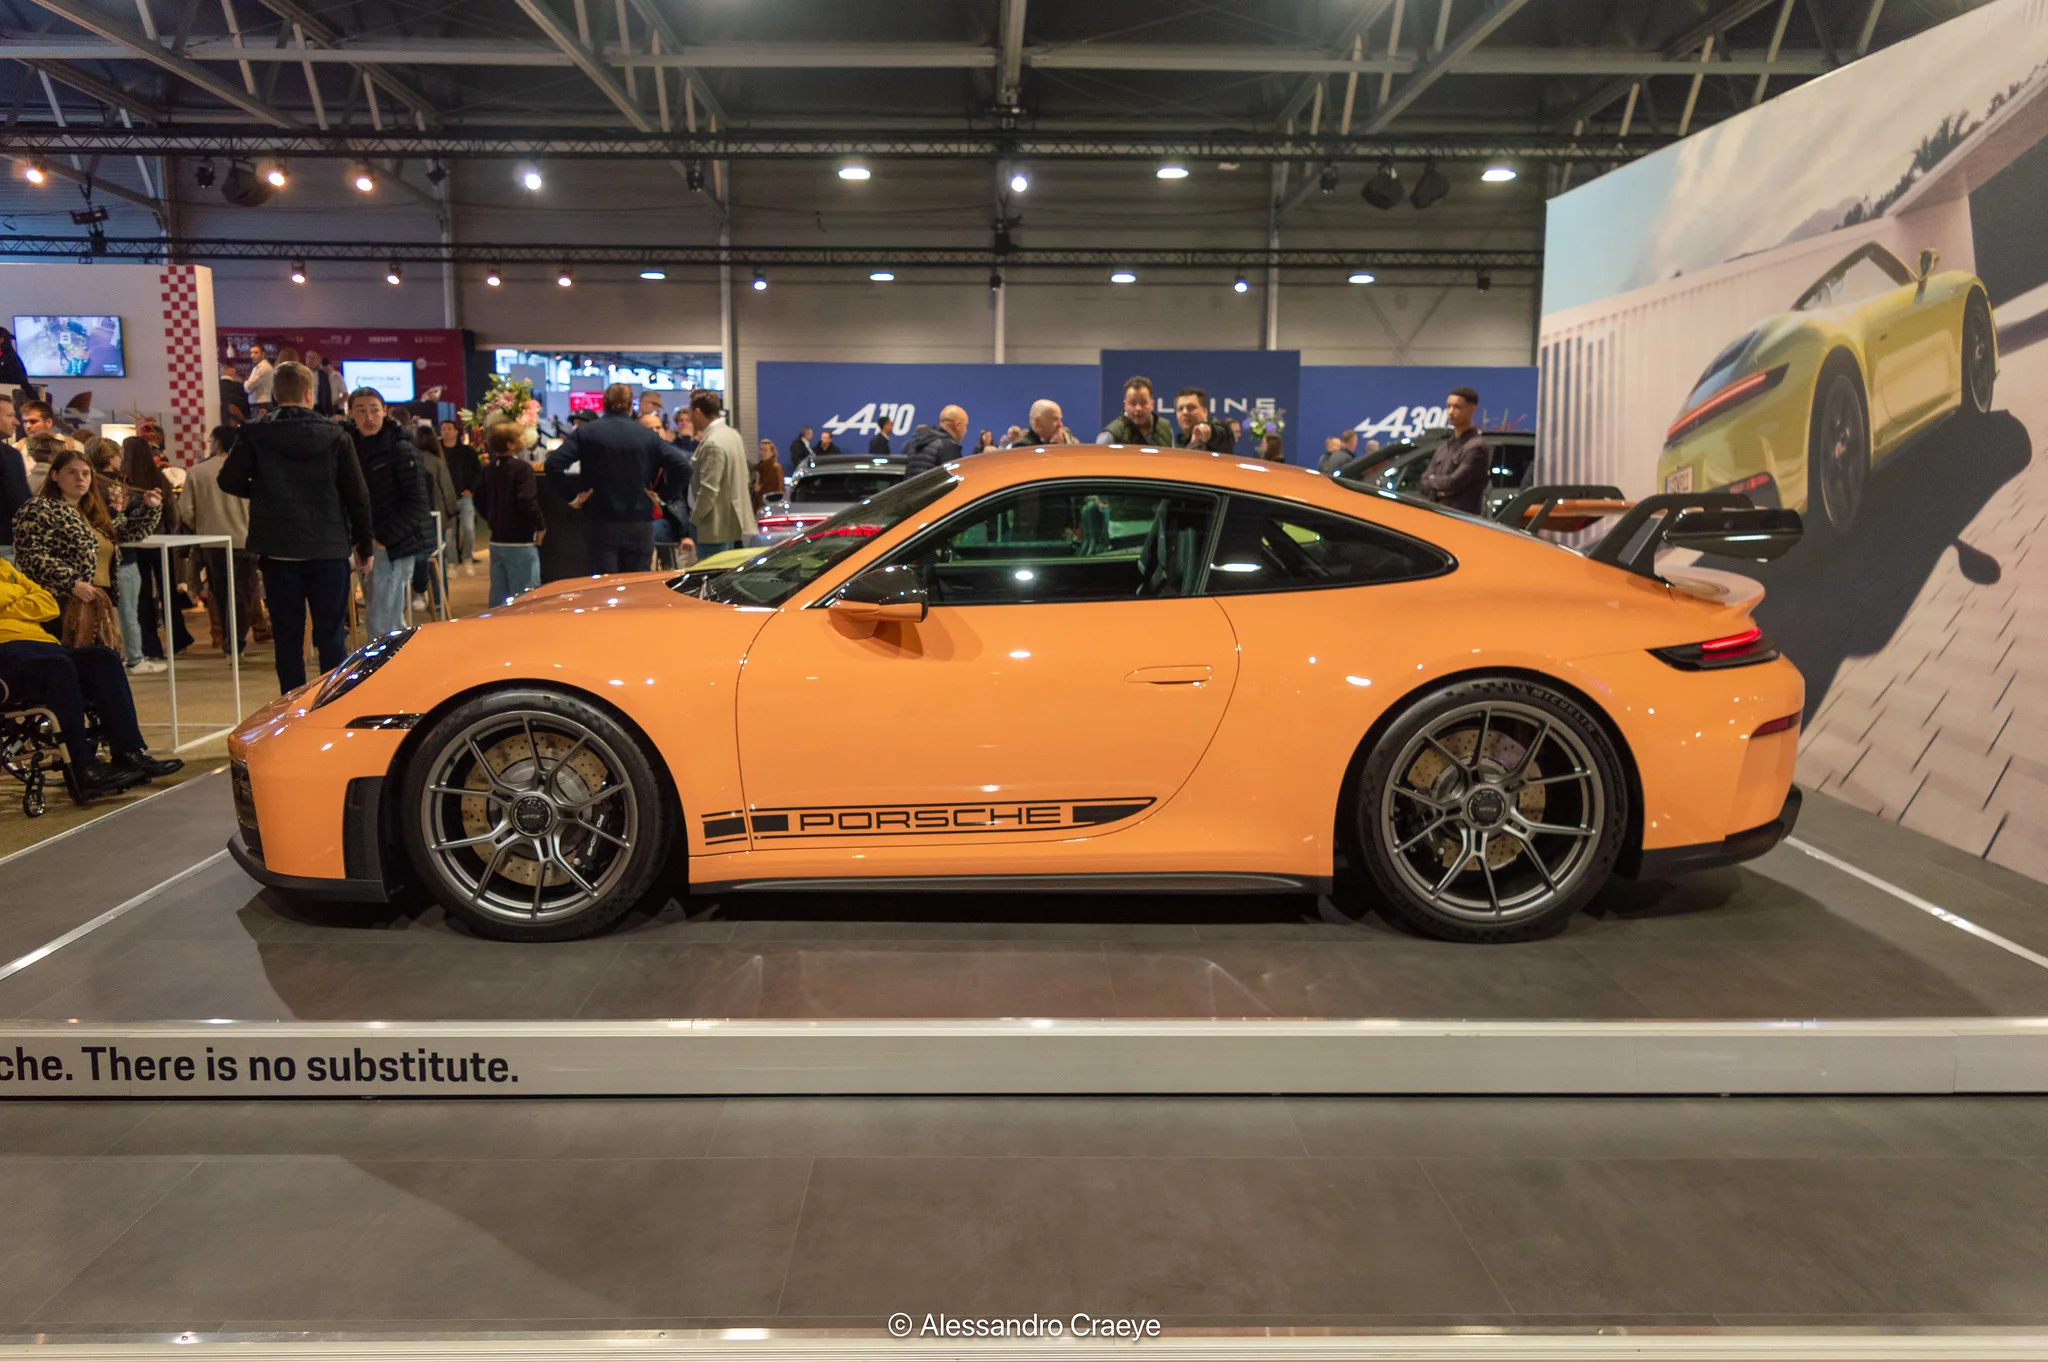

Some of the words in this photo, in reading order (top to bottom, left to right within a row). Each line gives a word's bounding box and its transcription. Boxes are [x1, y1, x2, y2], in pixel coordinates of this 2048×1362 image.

[800, 806, 1061, 832] PORSCHE
[81, 1046, 195, 1081] There
[206, 1046, 238, 1081] is
[249, 1056, 296, 1081] no
[307, 1047, 519, 1083] substitute.
